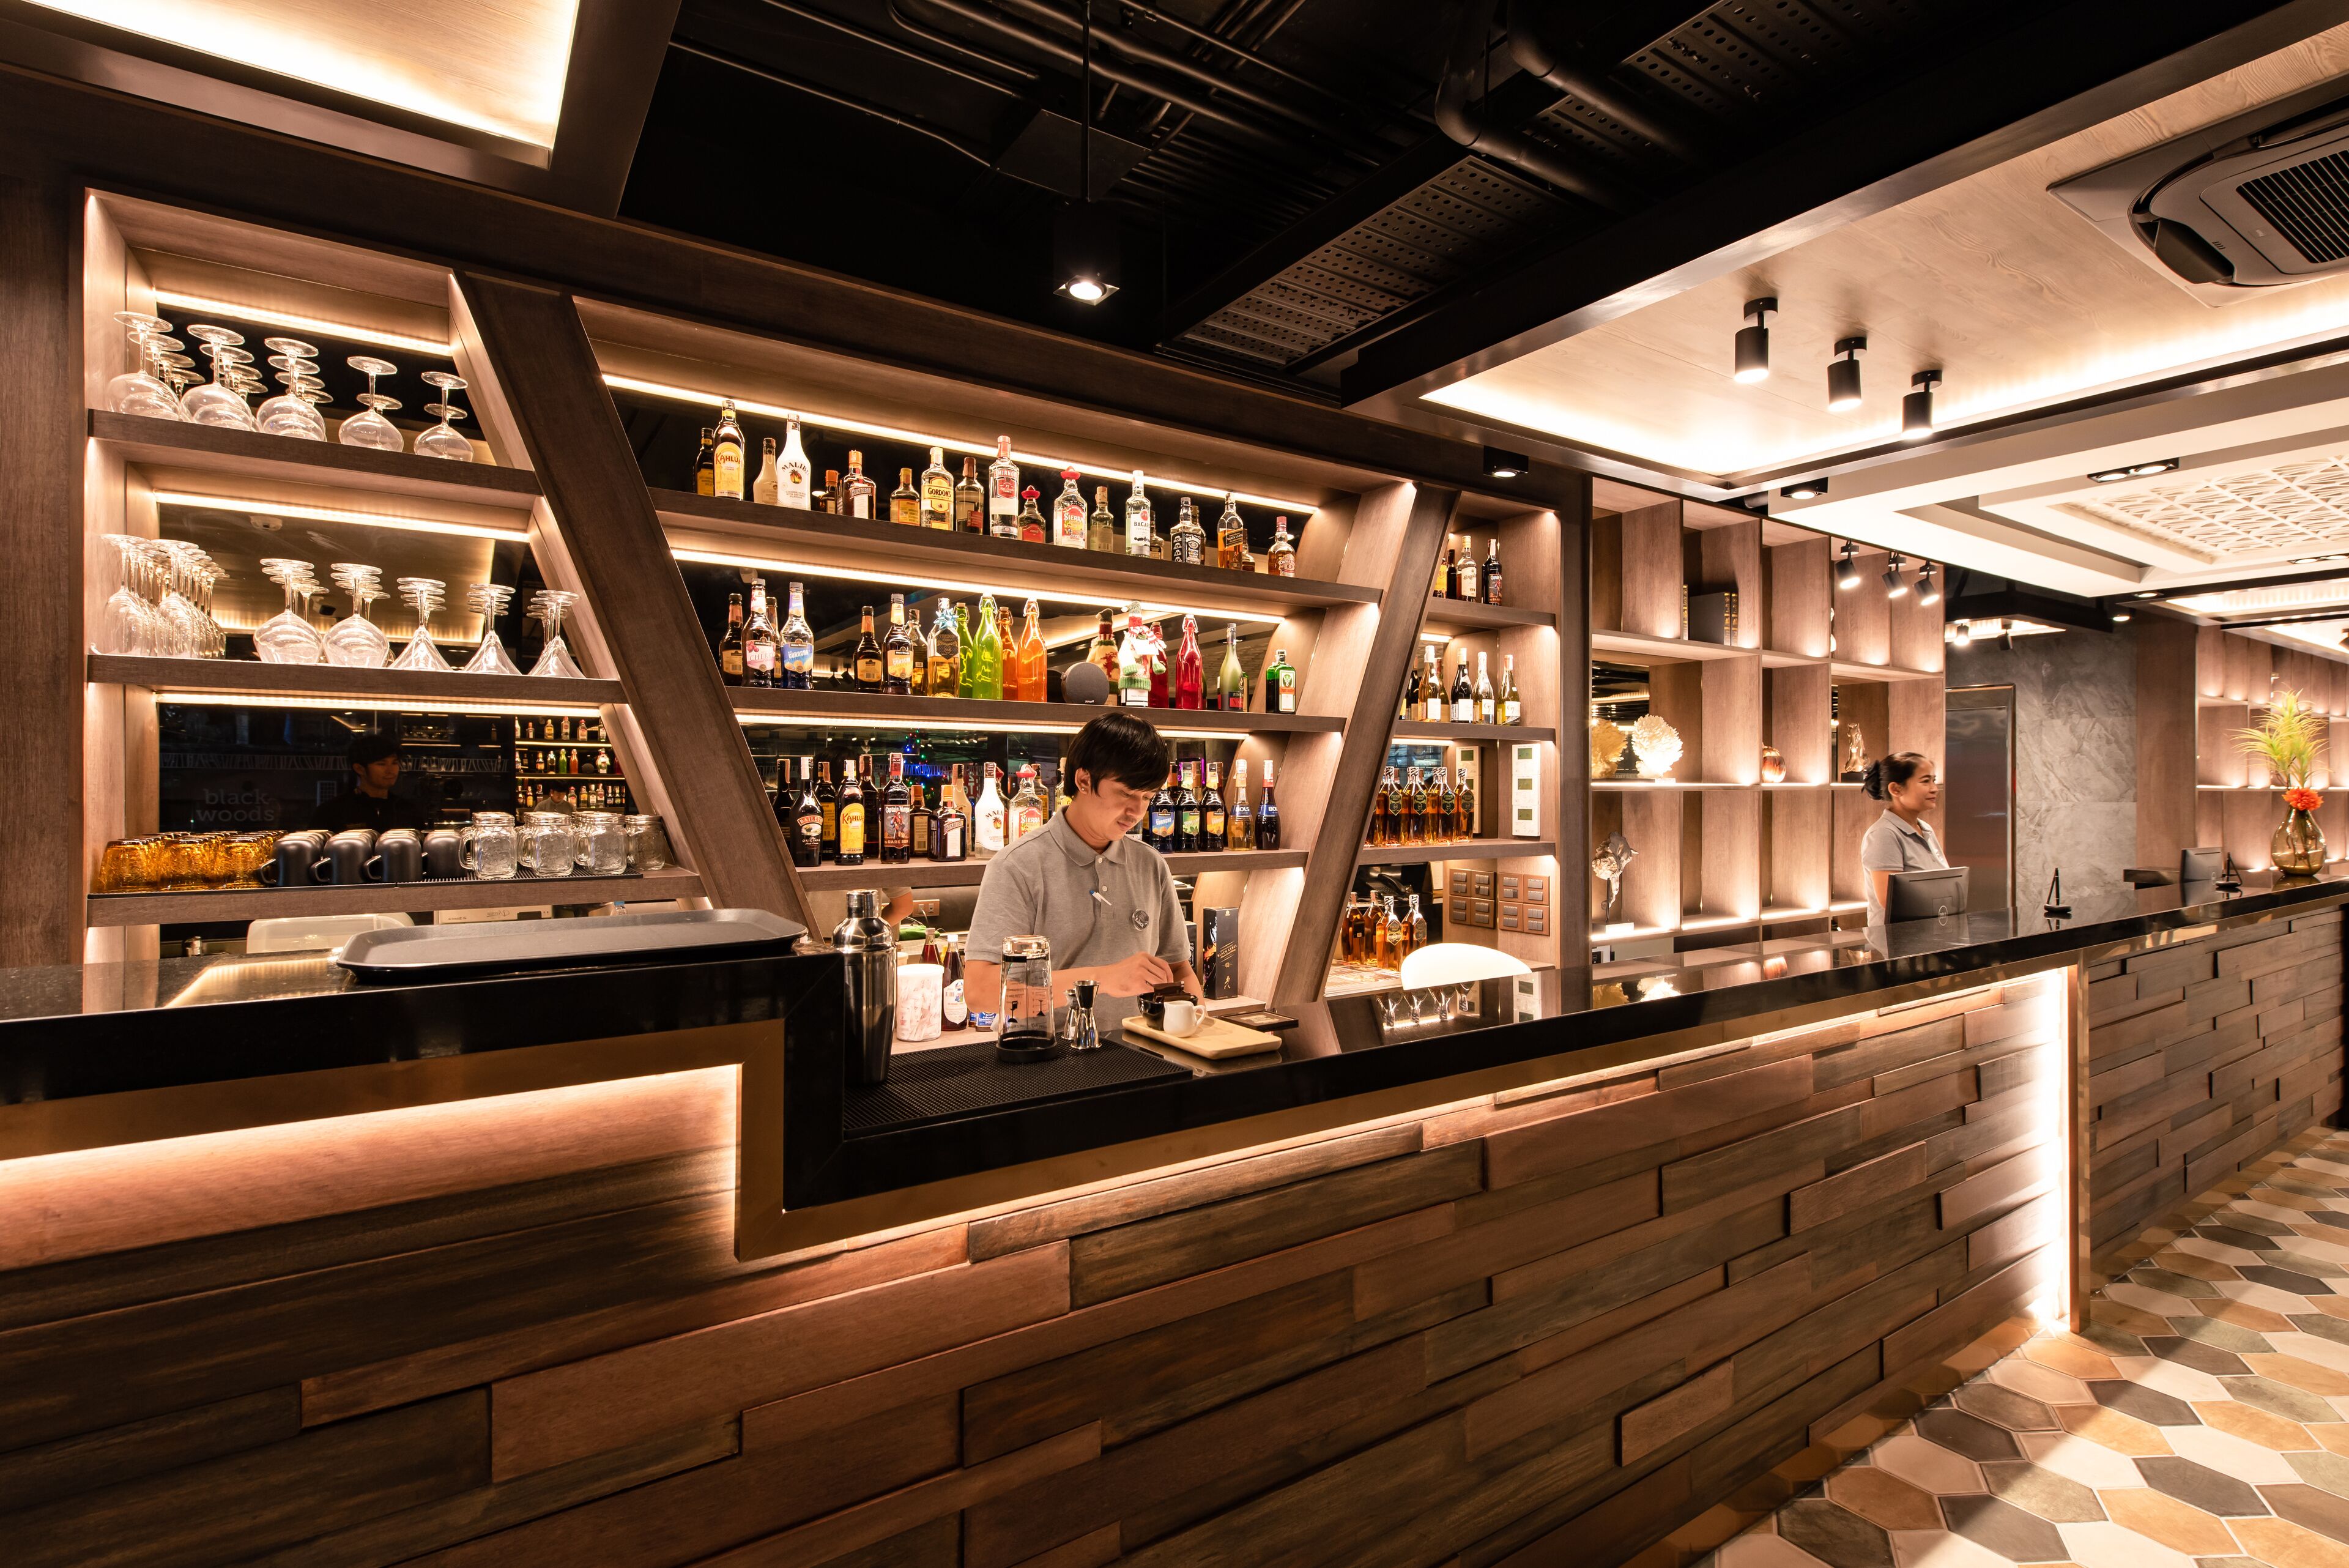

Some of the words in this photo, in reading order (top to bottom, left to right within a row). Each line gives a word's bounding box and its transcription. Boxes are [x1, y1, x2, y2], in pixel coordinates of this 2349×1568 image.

[1064, 512, 1083, 523] SIERRA
[203, 788, 270, 805] black
[196, 806, 275, 822] woods
[1020, 815, 1041, 823] SIERRA
[800, 816, 823, 824] BAILEYS
[1217, 949, 1228, 958] BLACK
